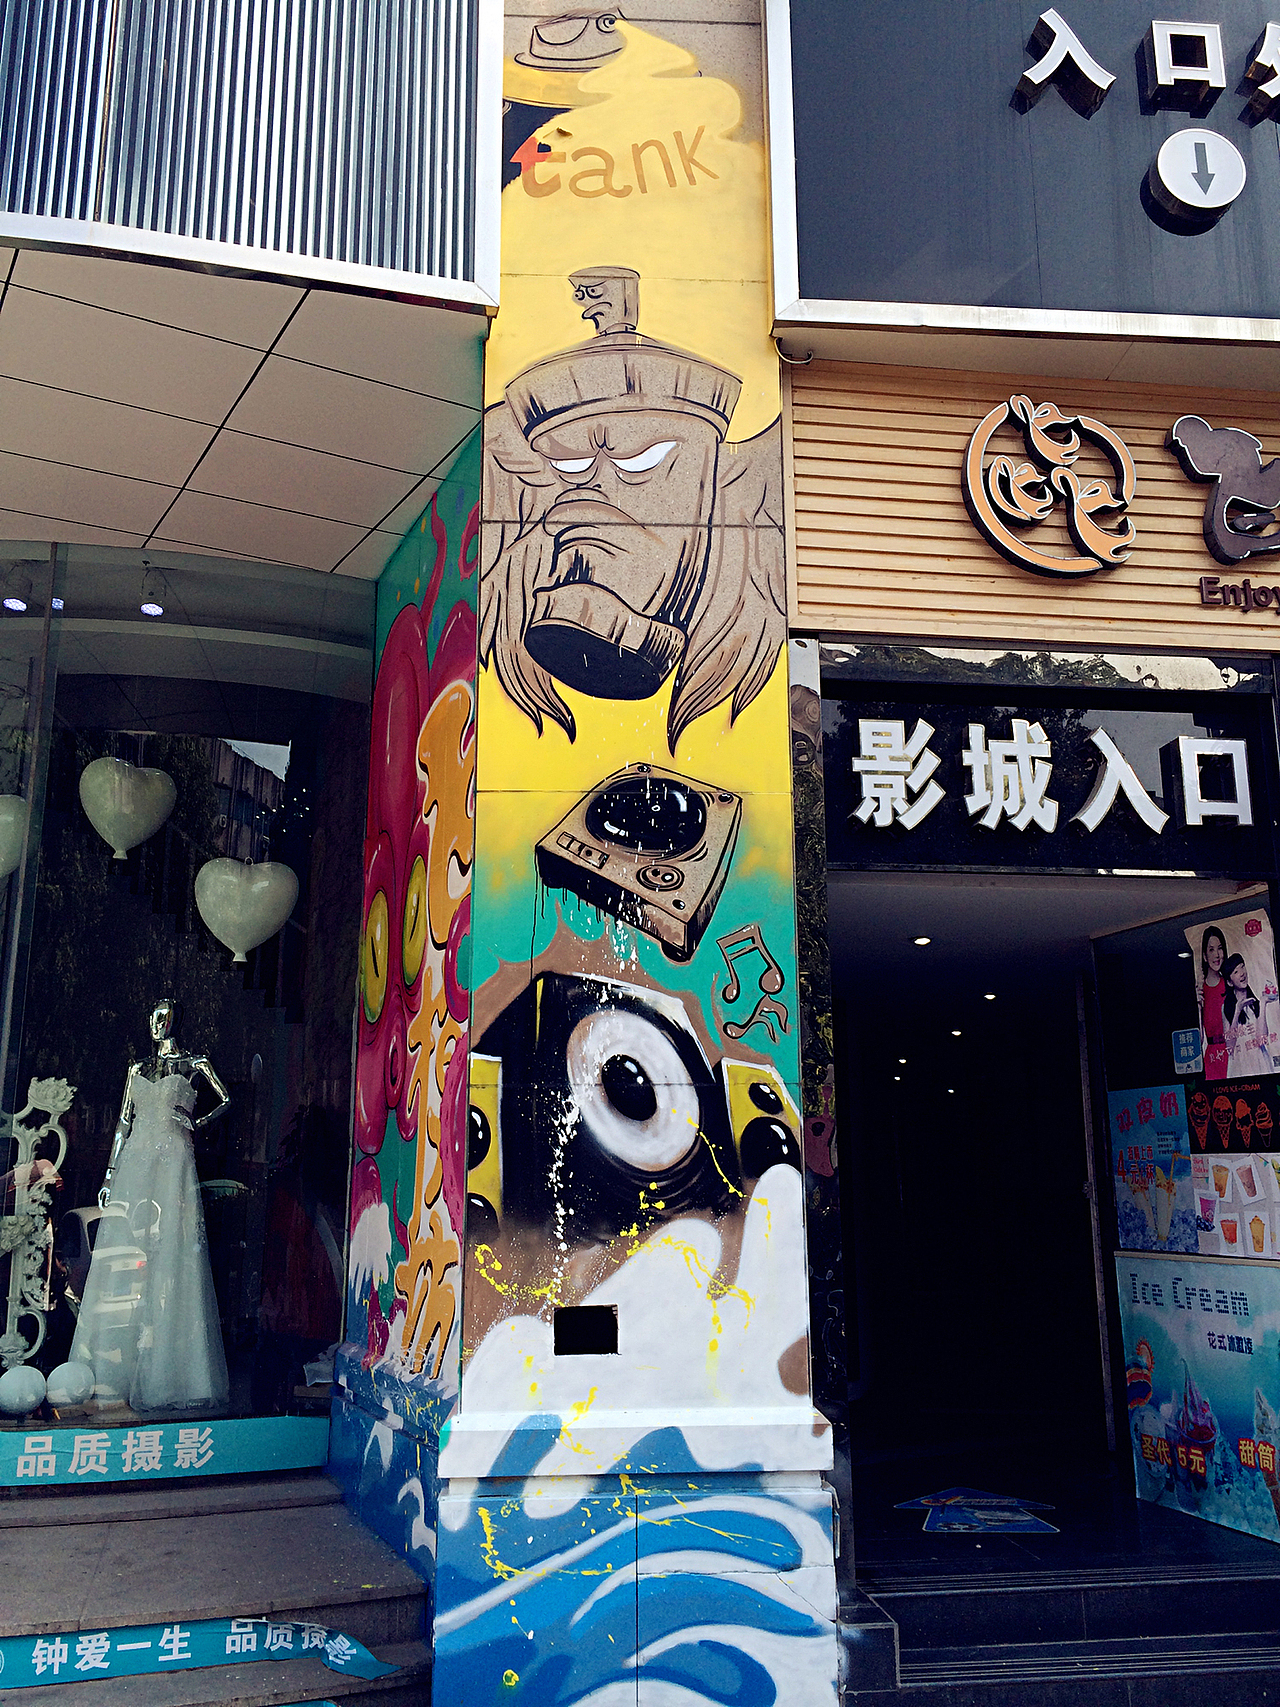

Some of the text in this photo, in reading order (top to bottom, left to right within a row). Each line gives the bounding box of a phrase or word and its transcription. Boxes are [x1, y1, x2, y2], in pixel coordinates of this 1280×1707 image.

[1021, 8, 1280, 99] 入口
[509, 125, 719, 198] tank
[850, 718, 1254, 834] 影城入口
[1115, 1091, 1179, 1134] 双皮奶
[1129, 1273, 1250, 1316] Ice Cream
[16, 1427, 215, 1477] 品质摄影
[1141, 1433, 1276, 1476] 圣代 5元 甜筒
[31, 1624, 192, 1676] 钟爱一生
